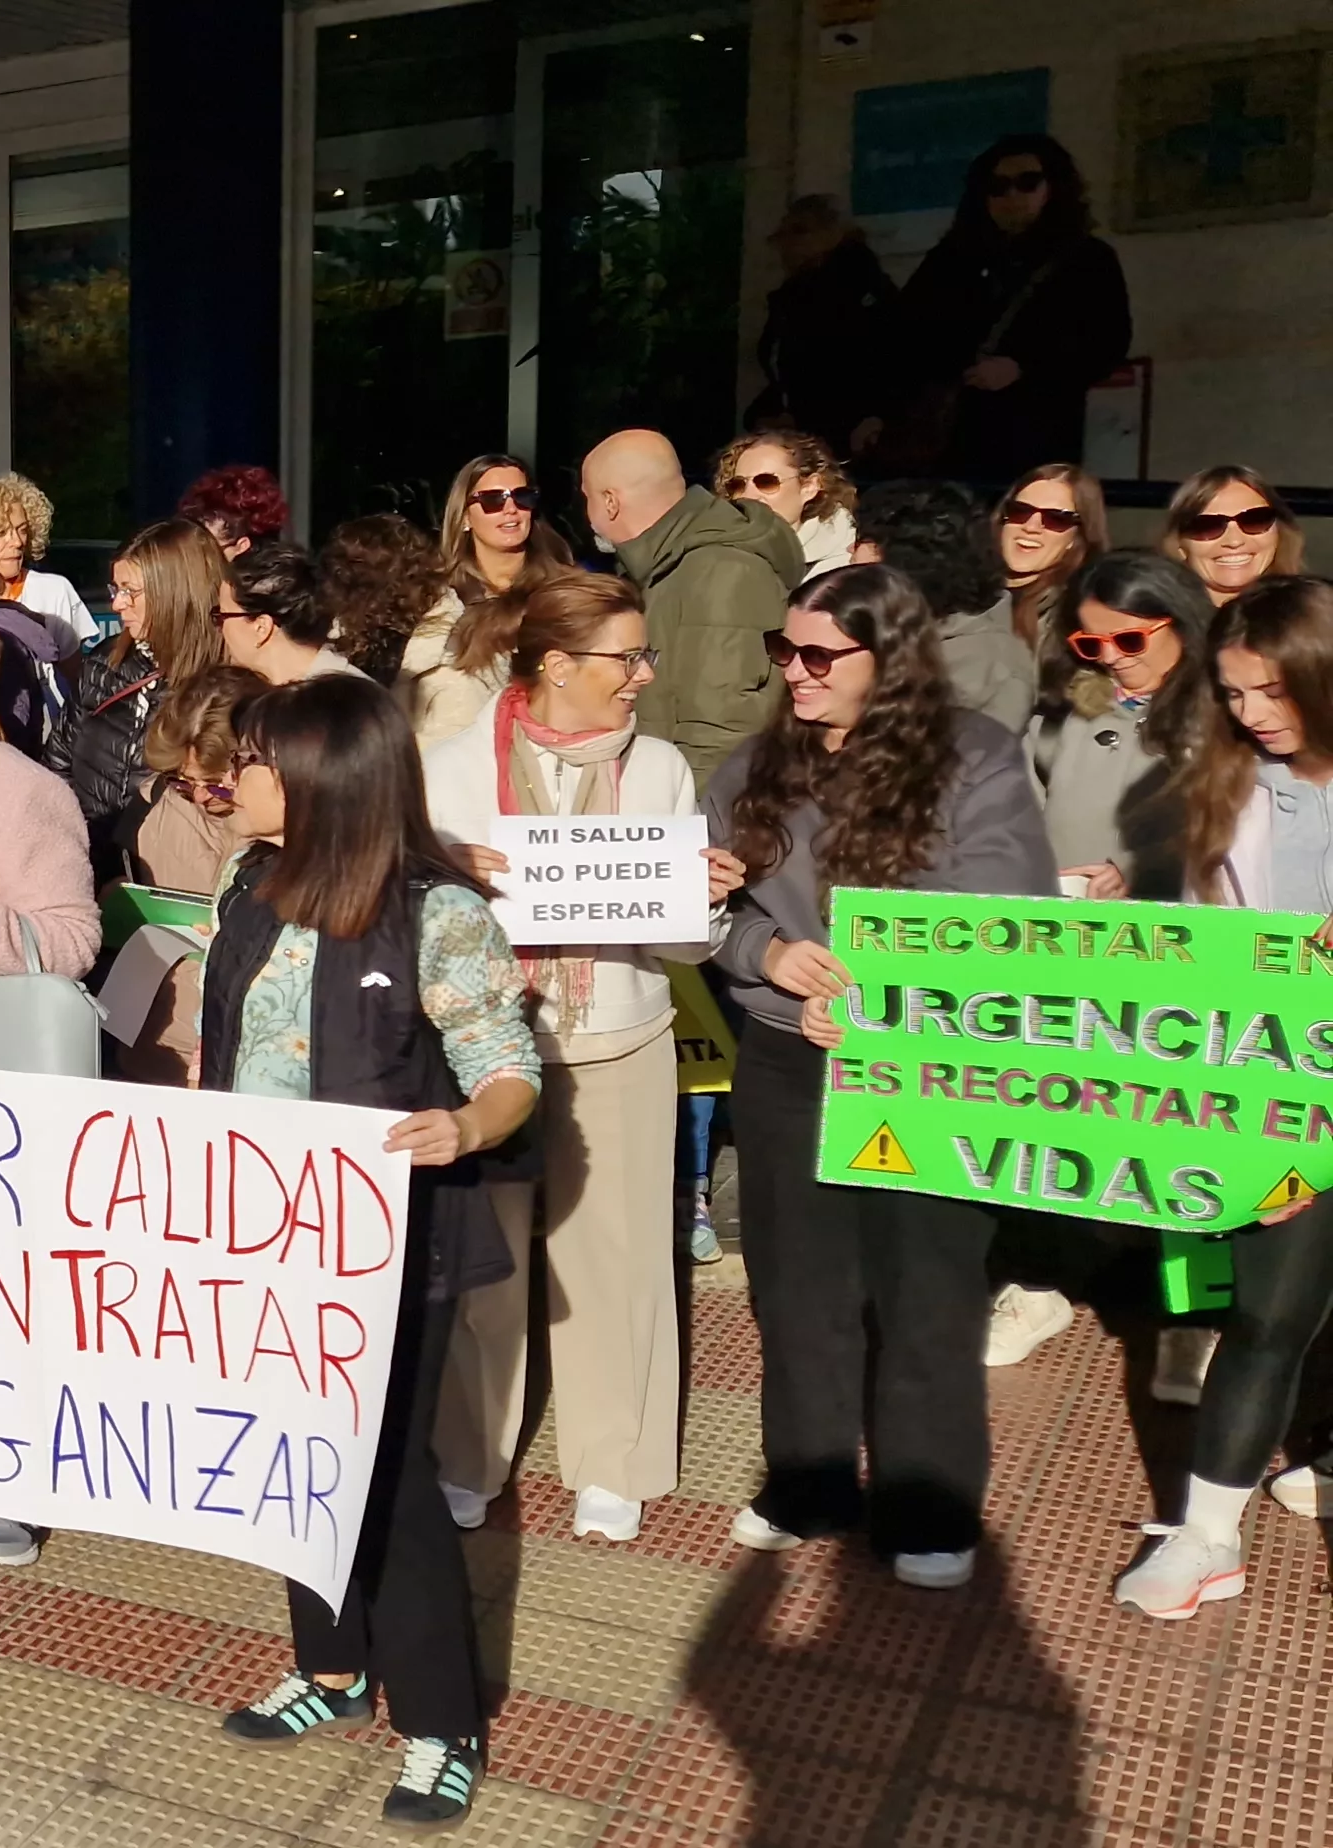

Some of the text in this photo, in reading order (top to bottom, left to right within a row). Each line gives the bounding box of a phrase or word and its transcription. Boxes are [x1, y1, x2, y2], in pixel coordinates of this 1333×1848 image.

[527, 826, 666, 845] MI SALUD
[524, 861, 672, 883] NO PUEDE
[532, 901, 667, 922] ESPERAR
[850, 914, 1196, 965] RECORTAR
[845, 982, 1333, 1080] URGENCIAS
[831, 1056, 1333, 1145] ES RECORTAR EN
[65, 1109, 396, 1278] CALIDAD
[951, 1135, 1225, 1222] VIDAS
